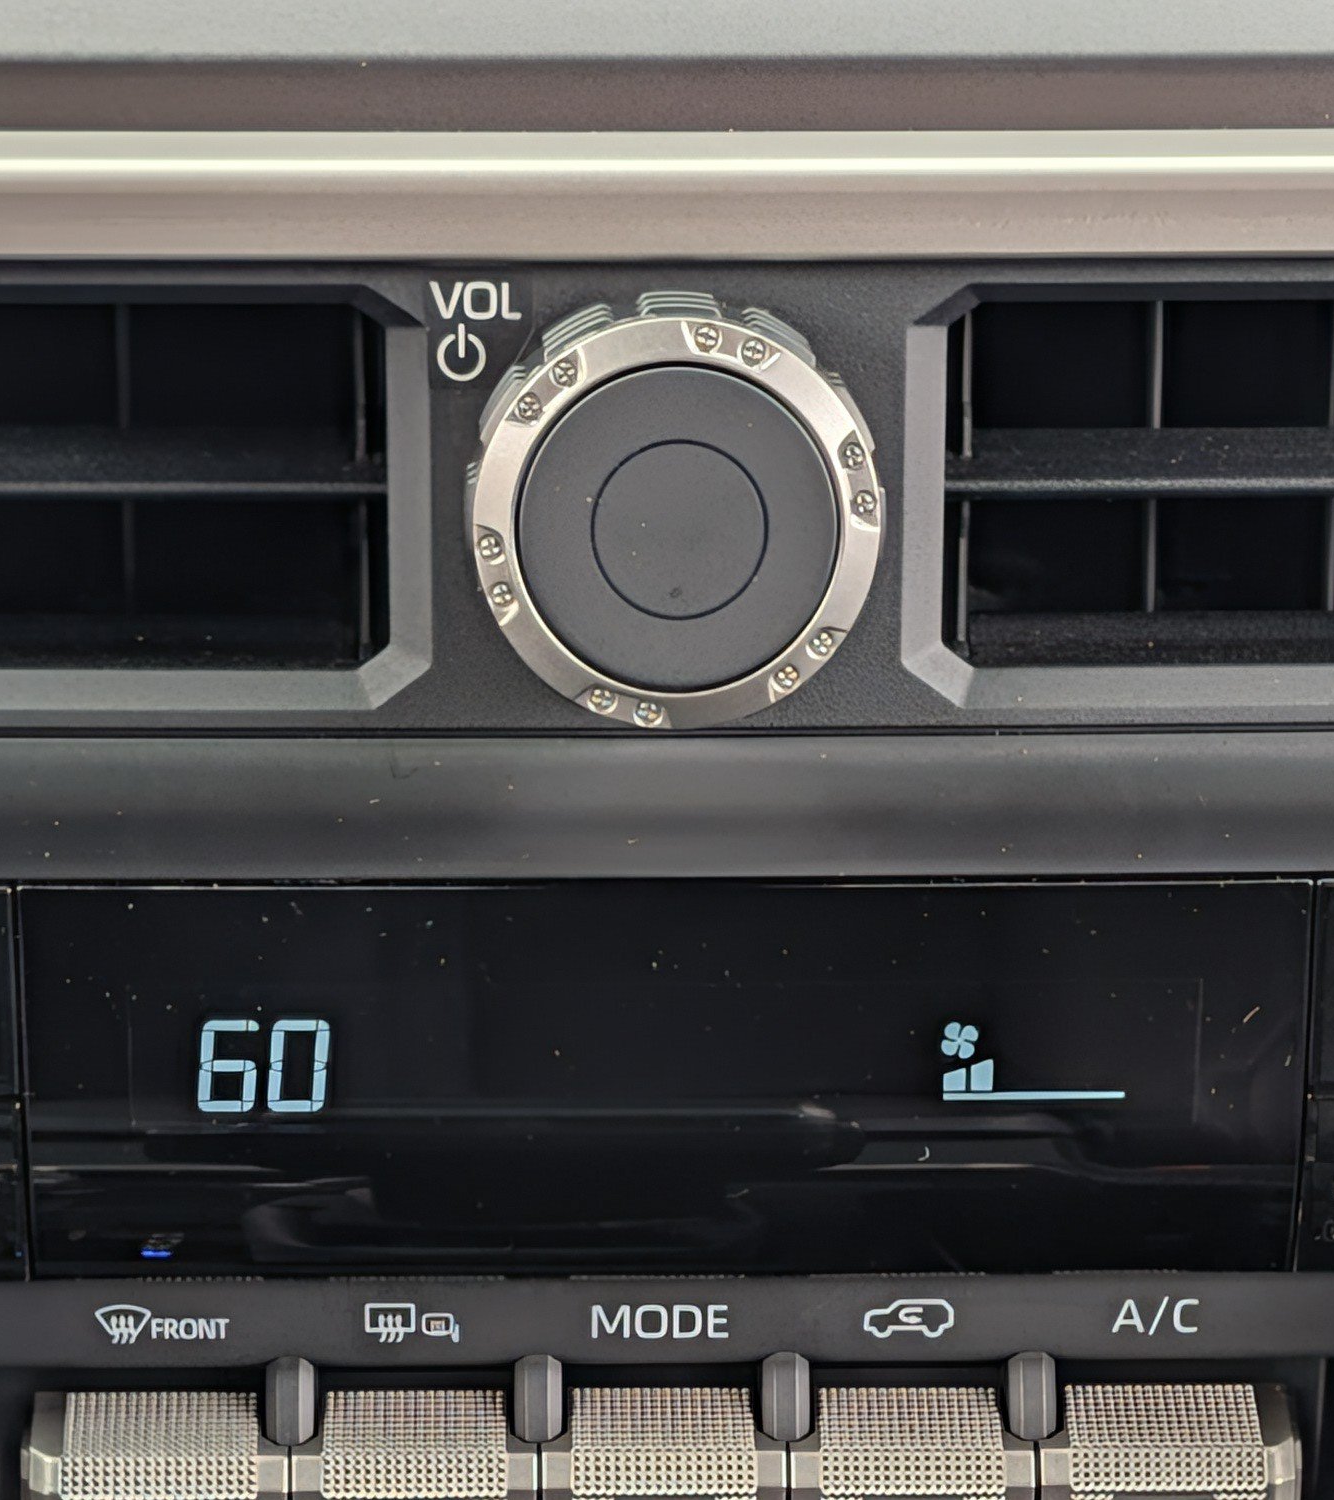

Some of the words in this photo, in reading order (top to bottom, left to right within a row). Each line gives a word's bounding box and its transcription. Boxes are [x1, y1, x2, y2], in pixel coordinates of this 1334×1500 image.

[429, 280, 523, 321] VOL
[197, 1018, 331, 1113] 60
[150, 1316, 230, 1341] FRONT
[590, 1303, 730, 1340] MODE
[1111, 1295, 1201, 1336] A/C
